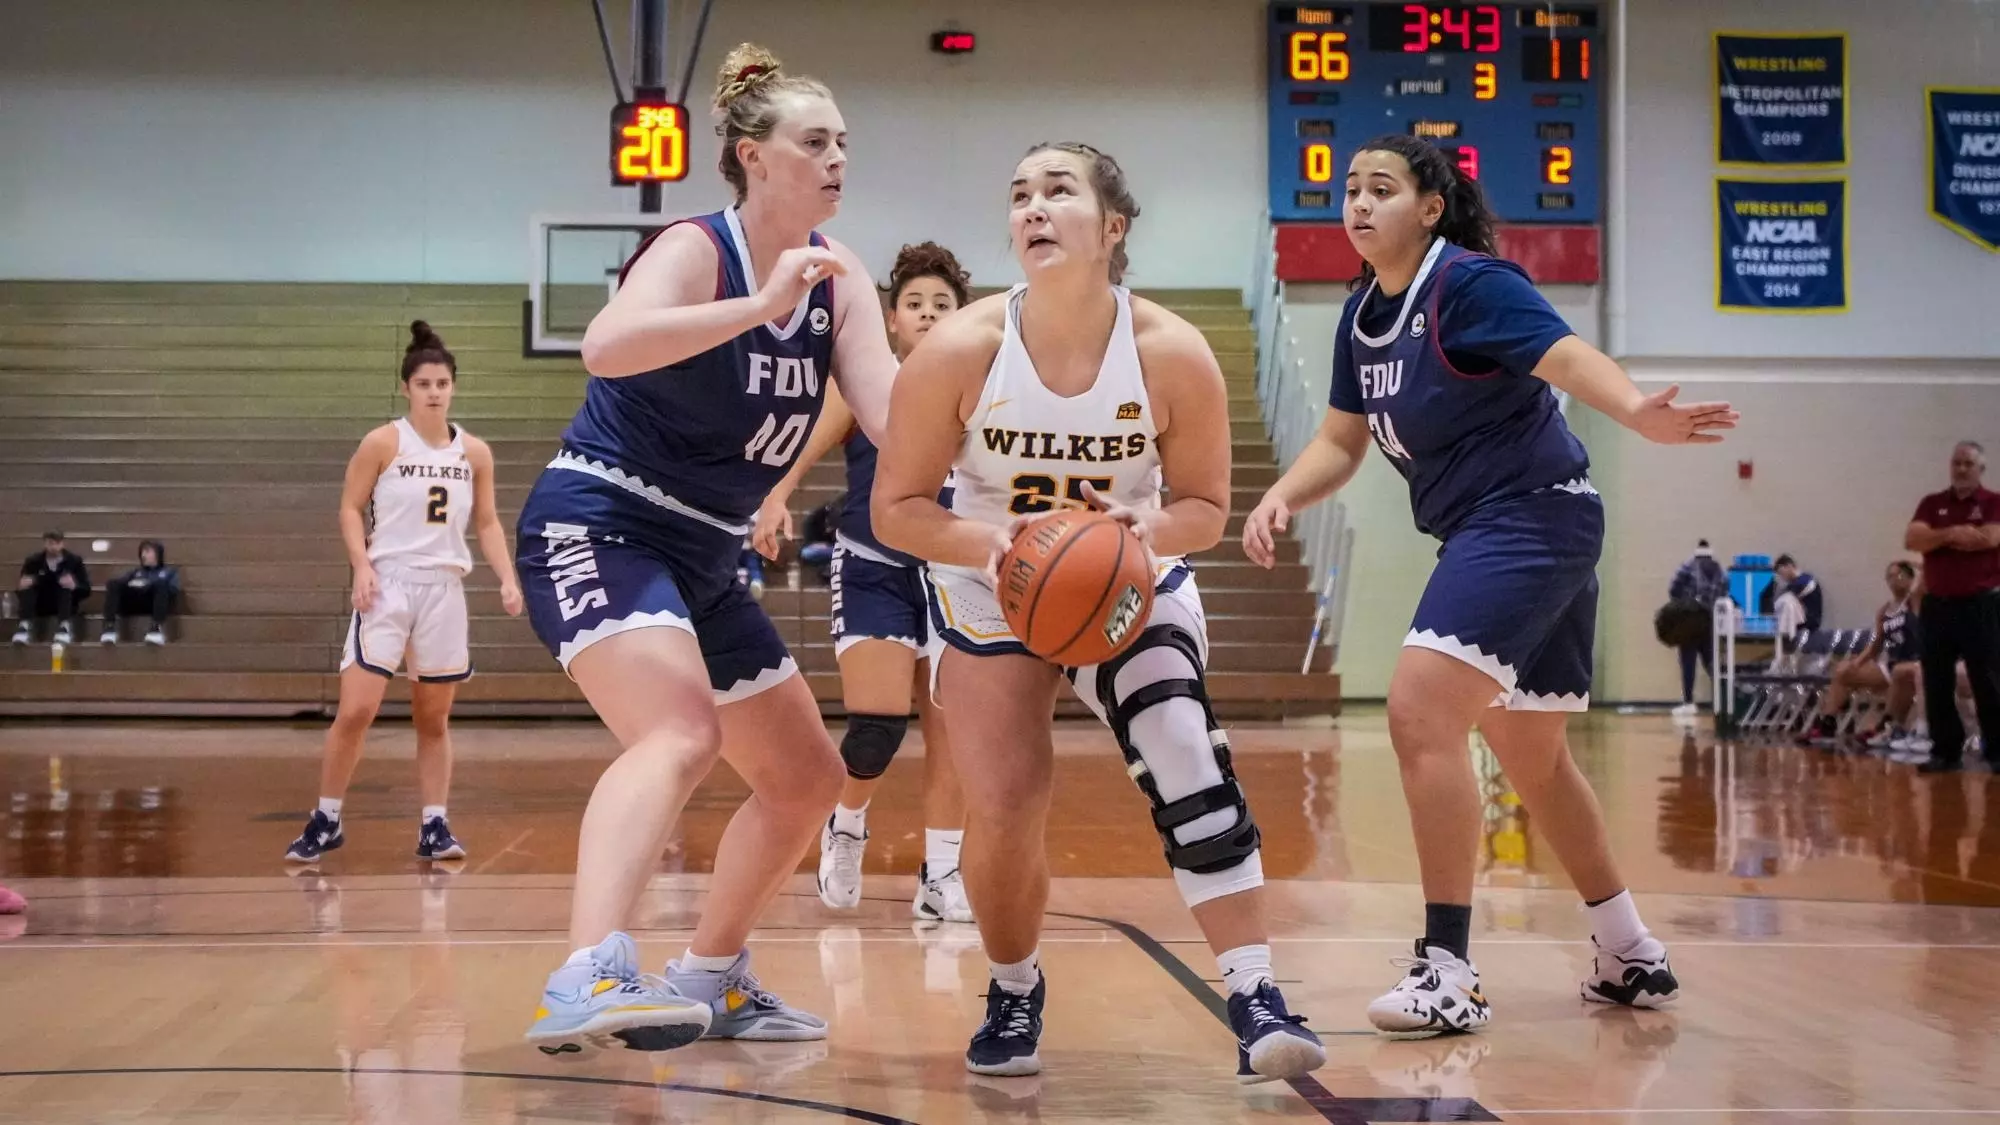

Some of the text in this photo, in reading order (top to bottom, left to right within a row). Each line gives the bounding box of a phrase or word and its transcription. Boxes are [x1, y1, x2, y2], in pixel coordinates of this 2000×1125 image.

[1403, 5, 1500, 52] 3:43
[1290, 32, 1349, 80] 66
[1551, 39, 1589, 80] 11
[1733, 57, 1827, 71] WRESTLING
[1400, 79, 1444, 95] period
[1475, 62, 1496, 99] 3
[1720, 85, 1842, 100] METROPOLITAN
[1733, 101, 1829, 116] CHAMPIONS
[1414, 122, 1457, 138] player
[1761, 131, 1802, 146] 2009
[619, 126, 682, 176] 20
[1306, 144, 1331, 182] 0
[1548, 146, 1572, 184] 2
[1734, 201, 1828, 216] WRESTLING
[1746, 219, 1817, 243] NCAA
[1732, 246, 1831, 261] EAST REGION
[1735, 262, 1828, 277] CHAMPIONS
[1763, 282, 1800, 297] 2014
[746, 353, 819, 397] FDU
[1359, 360, 1403, 399] FDU
[983, 428, 1146, 462] WILKES
[398, 464, 470, 481] WILKES
[426, 485, 448, 524] 2
[1110, 591, 1142, 645] MAC
